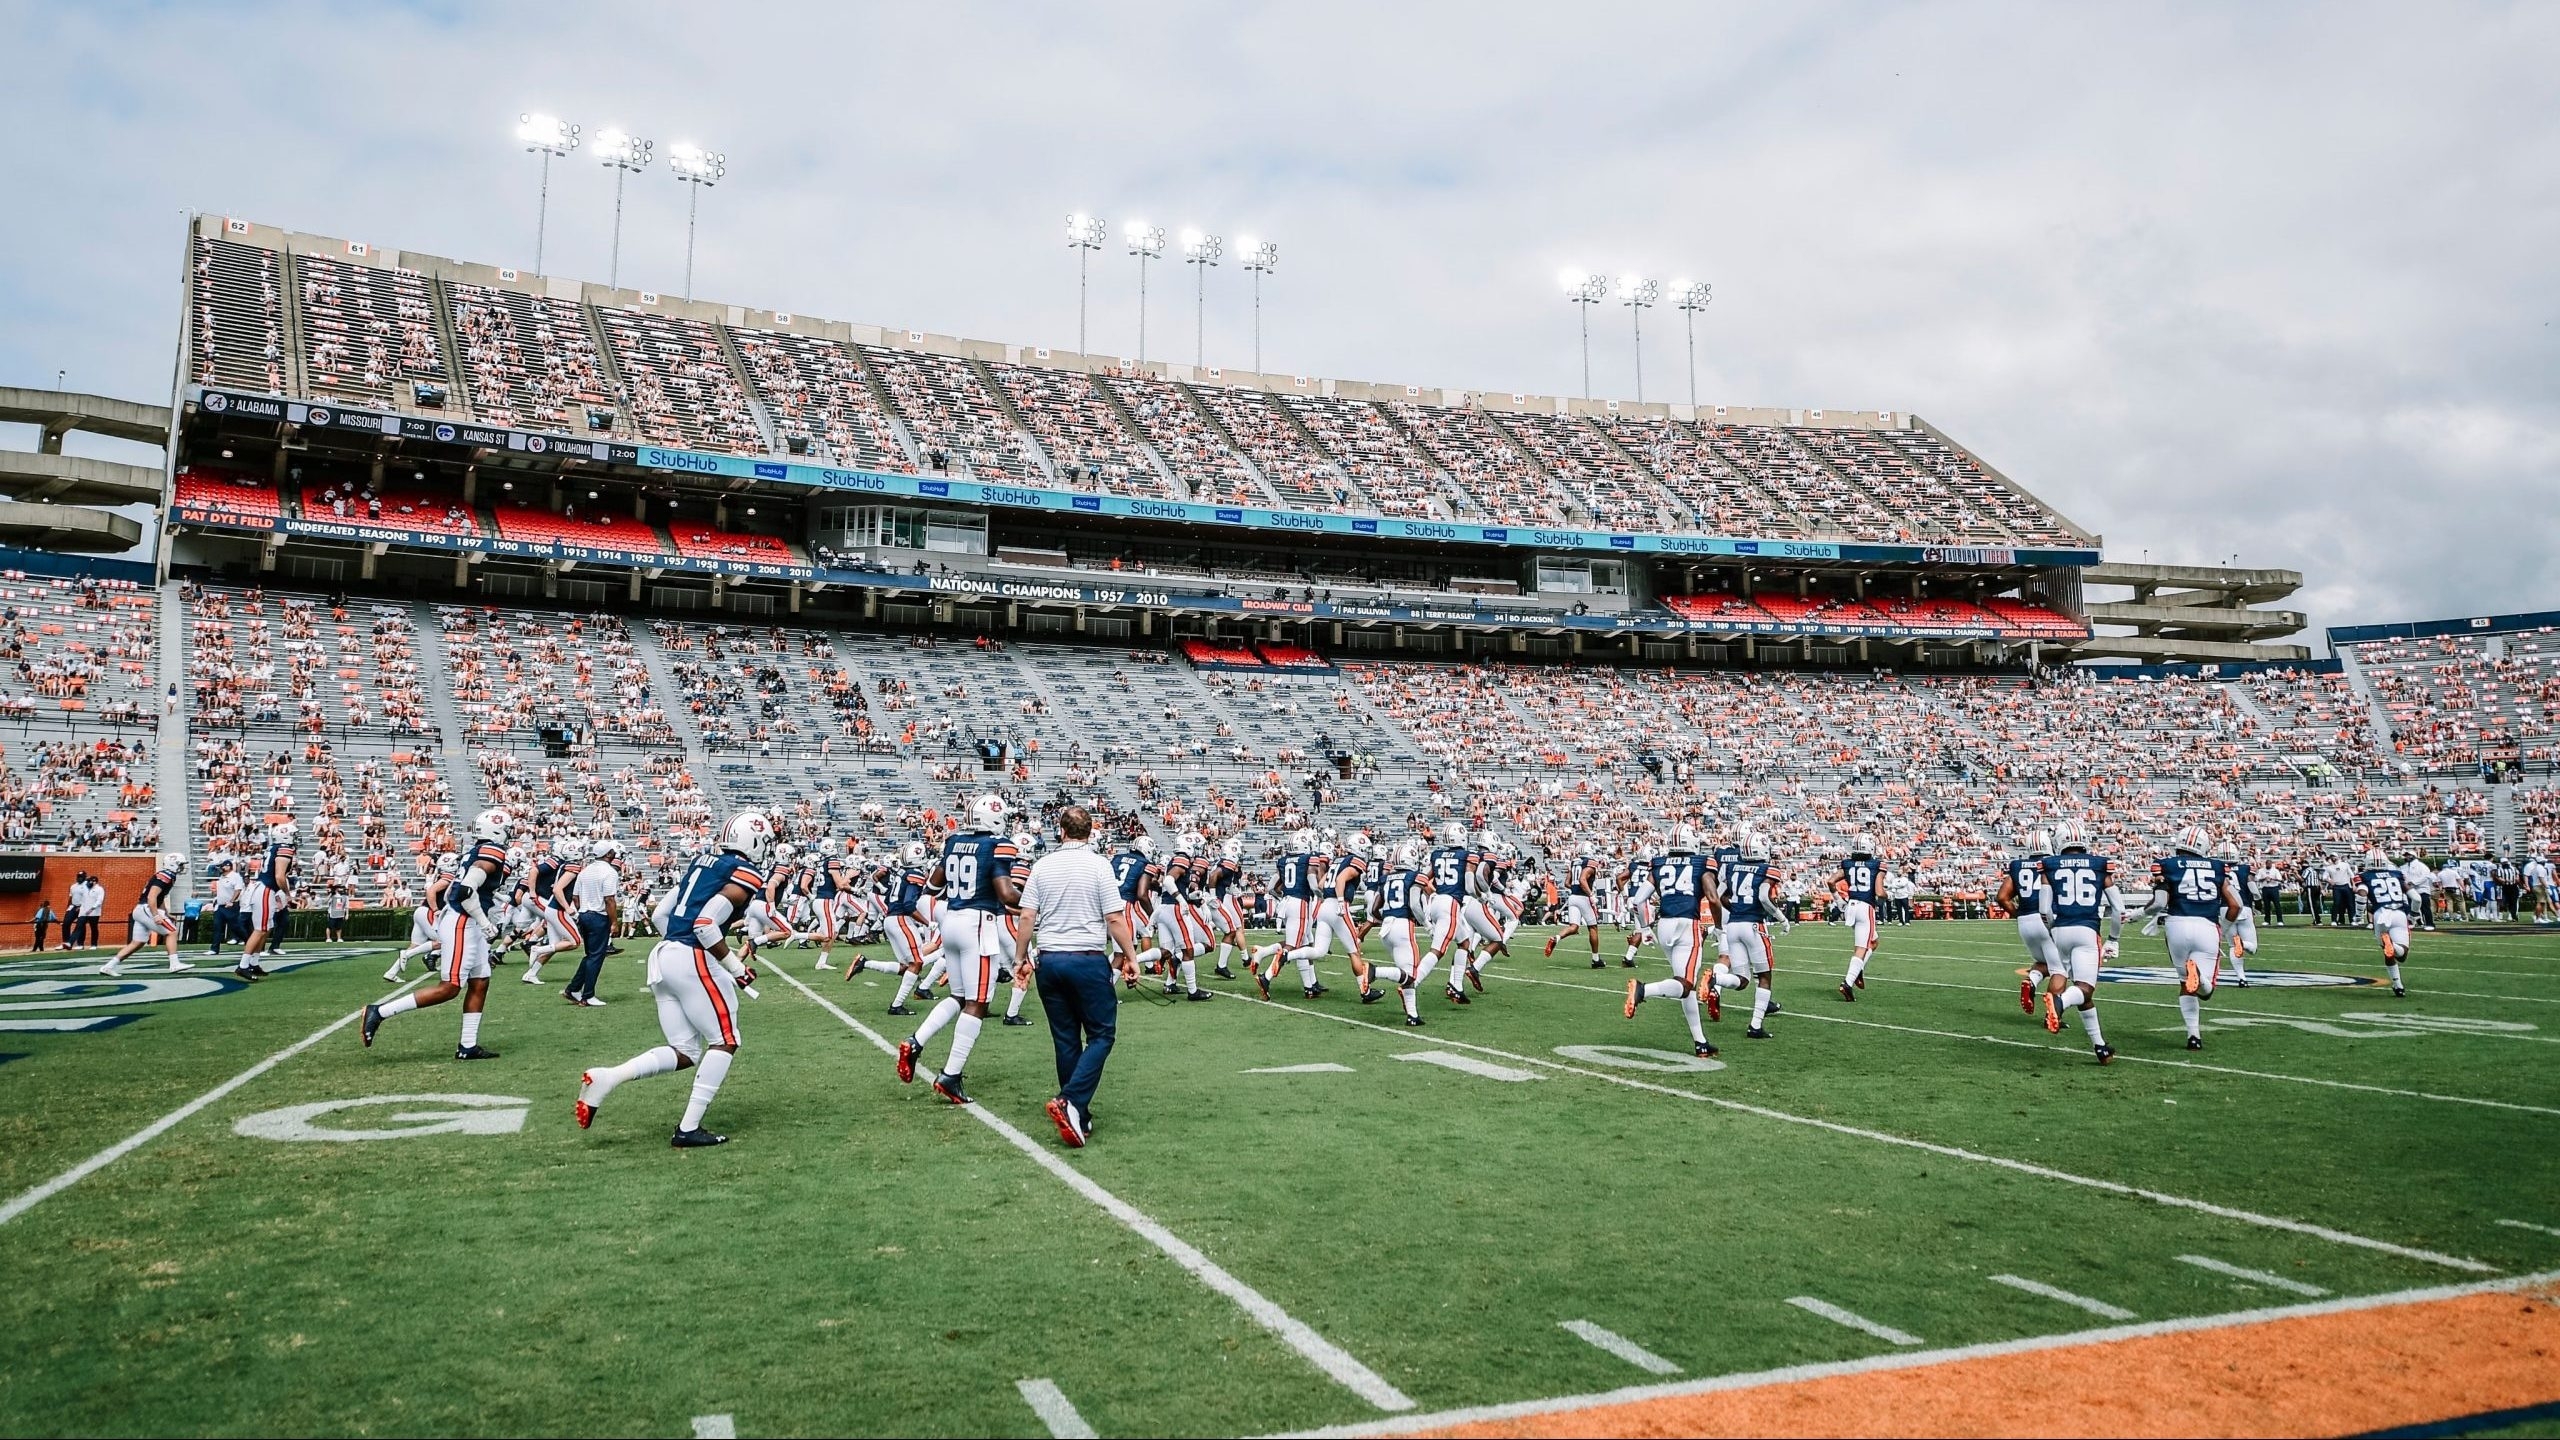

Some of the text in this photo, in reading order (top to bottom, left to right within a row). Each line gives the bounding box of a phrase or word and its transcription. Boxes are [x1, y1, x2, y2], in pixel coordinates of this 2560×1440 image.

[231, 222, 245, 231] 62
[351, 245, 363, 253] 61
[502, 271, 514, 279] 60
[230, 400, 279, 415] 2 ALABAMA
[339, 414, 381, 429] MISSOURI
[406, 422, 425, 430] 7:00
[463, 430, 505, 444] KANSAS ST
[555, 441, 591, 455] OKLAHOMA
[611, 450, 635, 458] 12:00
[650, 451, 718, 471] StubHub
[758, 467, 783, 476] StubHub
[822, 471, 885, 490] StubHub
[922, 484, 945, 492] StubHub
[982, 487, 1040, 505] StubHub
[1075, 499, 1097, 507] StubHub
[1131, 502, 1186, 518] StubHub
[181, 510, 274, 528] PAT DYE FIELD
[1271, 514, 1323, 529] StubHub
[1405, 524, 1455, 538] StubHub
[1534, 532, 1583, 546] StubHub
[1661, 539, 1708, 552] StubHub
[266, 549, 276, 557] 11
[286, 520, 812, 578] UNDEFEATED SEASONS 1893 1897 1900 1904 1913 1914 1932 1957 1958 1993 2004 2010
[1785, 545, 1831, 557] StubHub
[1948, 549, 2010, 563] AUBURN TIGERS
[929, 578, 1168, 605] NATIONAL CHAMPIONS 1957 2010
[1242, 600, 1313, 613] BROADWAY CLUB
[1357, 608, 1390, 616] SULLIVAN
[1447, 612, 1476, 620] BEASLEY
[1617, 619, 1634, 627] 2013
[1667, 620, 1684, 628] 2010
[1712, 622, 1729, 630] 1989
[1758, 623, 1774, 631] 1987
[1802, 625, 1819, 633] 1957
[1847, 626, 1864, 634] 1919
[1892, 627, 1908, 635] 1913
[1954, 629, 1994, 637] CHAMPIONS
[2000, 629, 2031, 637] JORDAN
[2032, 630, 2054, 638] HARE
[2054, 630, 2088, 638] STADIUM
[2060, 859, 2090, 868] SIMPSON
[2185, 861, 2212, 869] JOHNSON
[0, 871, 36, 880] verizon
[945, 854, 978, 900] 99
[1114, 864, 1129, 887] 3
[1285, 862, 1297, 889] 0
[1434, 858, 1459, 886] 35
[1848, 867, 1871, 892] 19
[1659, 865, 1694, 896] 24
[1728, 871, 1754, 904] 14
[2018, 868, 2042, 898] 94
[2054, 868, 2097, 907] 36
[2178, 868, 2218, 901] 45
[676, 867, 702, 917] 1
[1381, 880, 1404, 911] 13
[2370, 877, 2403, 904] 28
[233, 1093, 532, 1142] G
